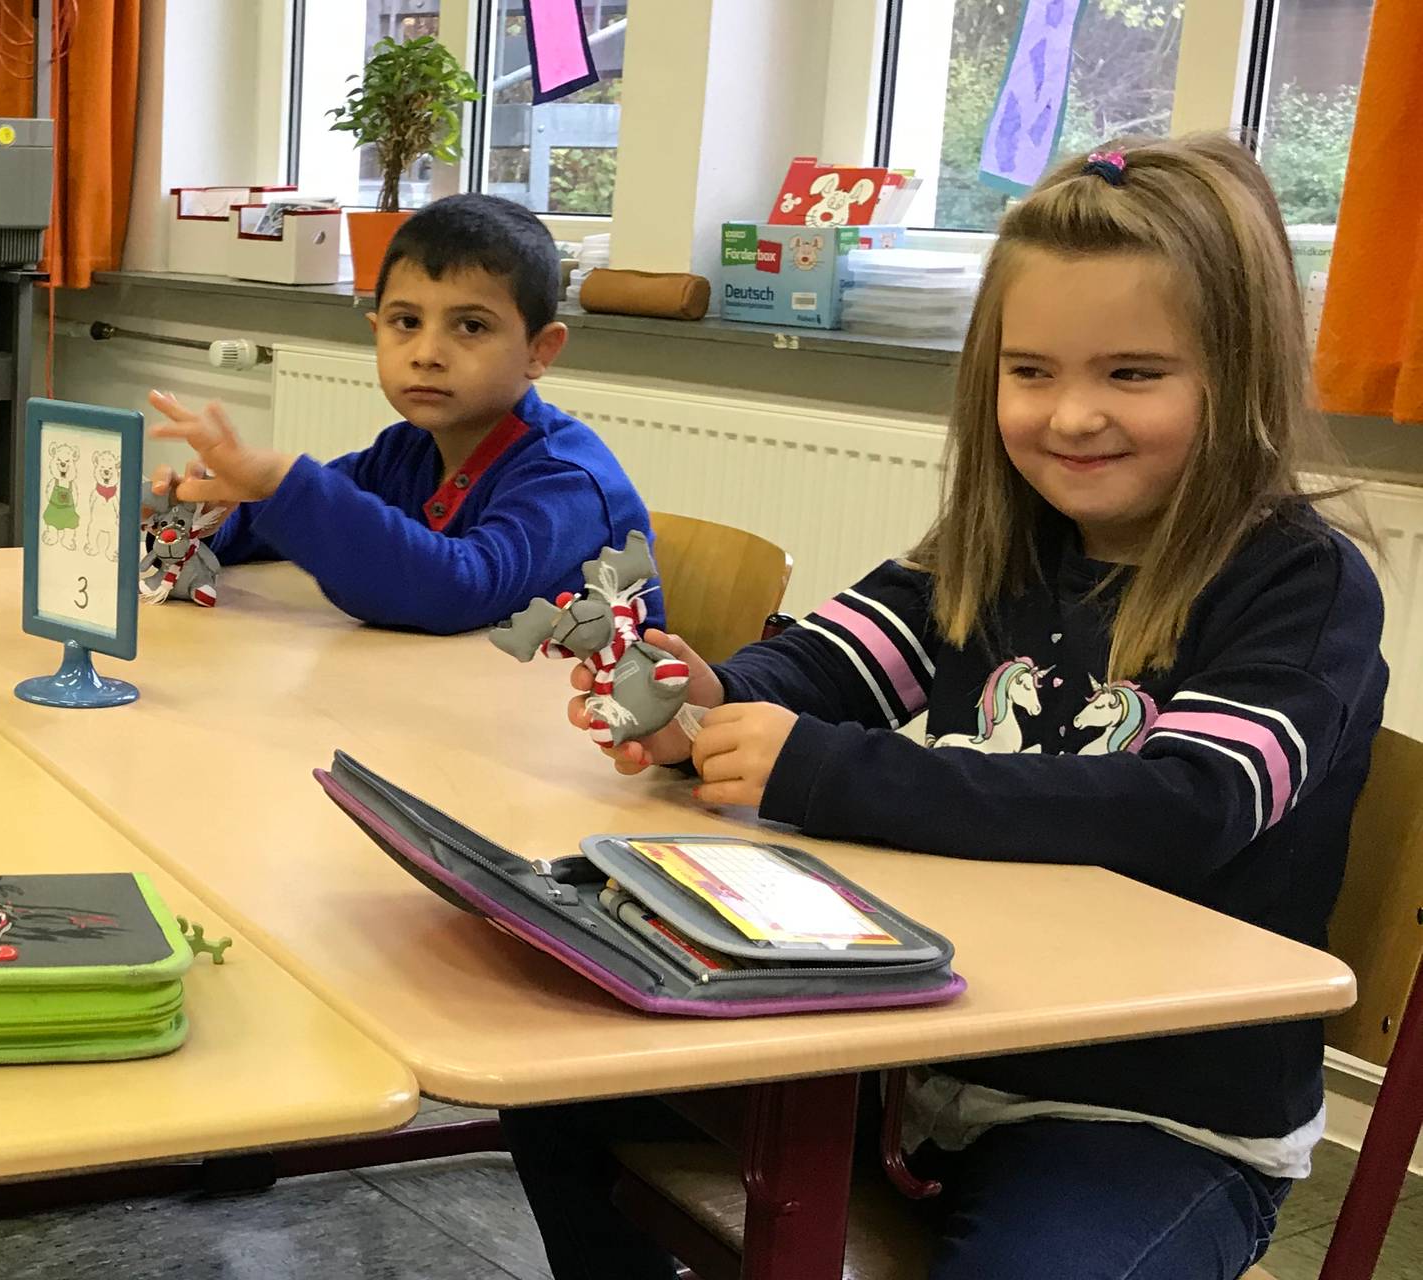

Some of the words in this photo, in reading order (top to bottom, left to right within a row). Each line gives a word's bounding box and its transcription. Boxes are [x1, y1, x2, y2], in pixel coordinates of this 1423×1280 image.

[725, 248, 777, 262] Förderbox
[725, 284, 775, 301] Deutsch
[73, 576, 89, 609] 3
